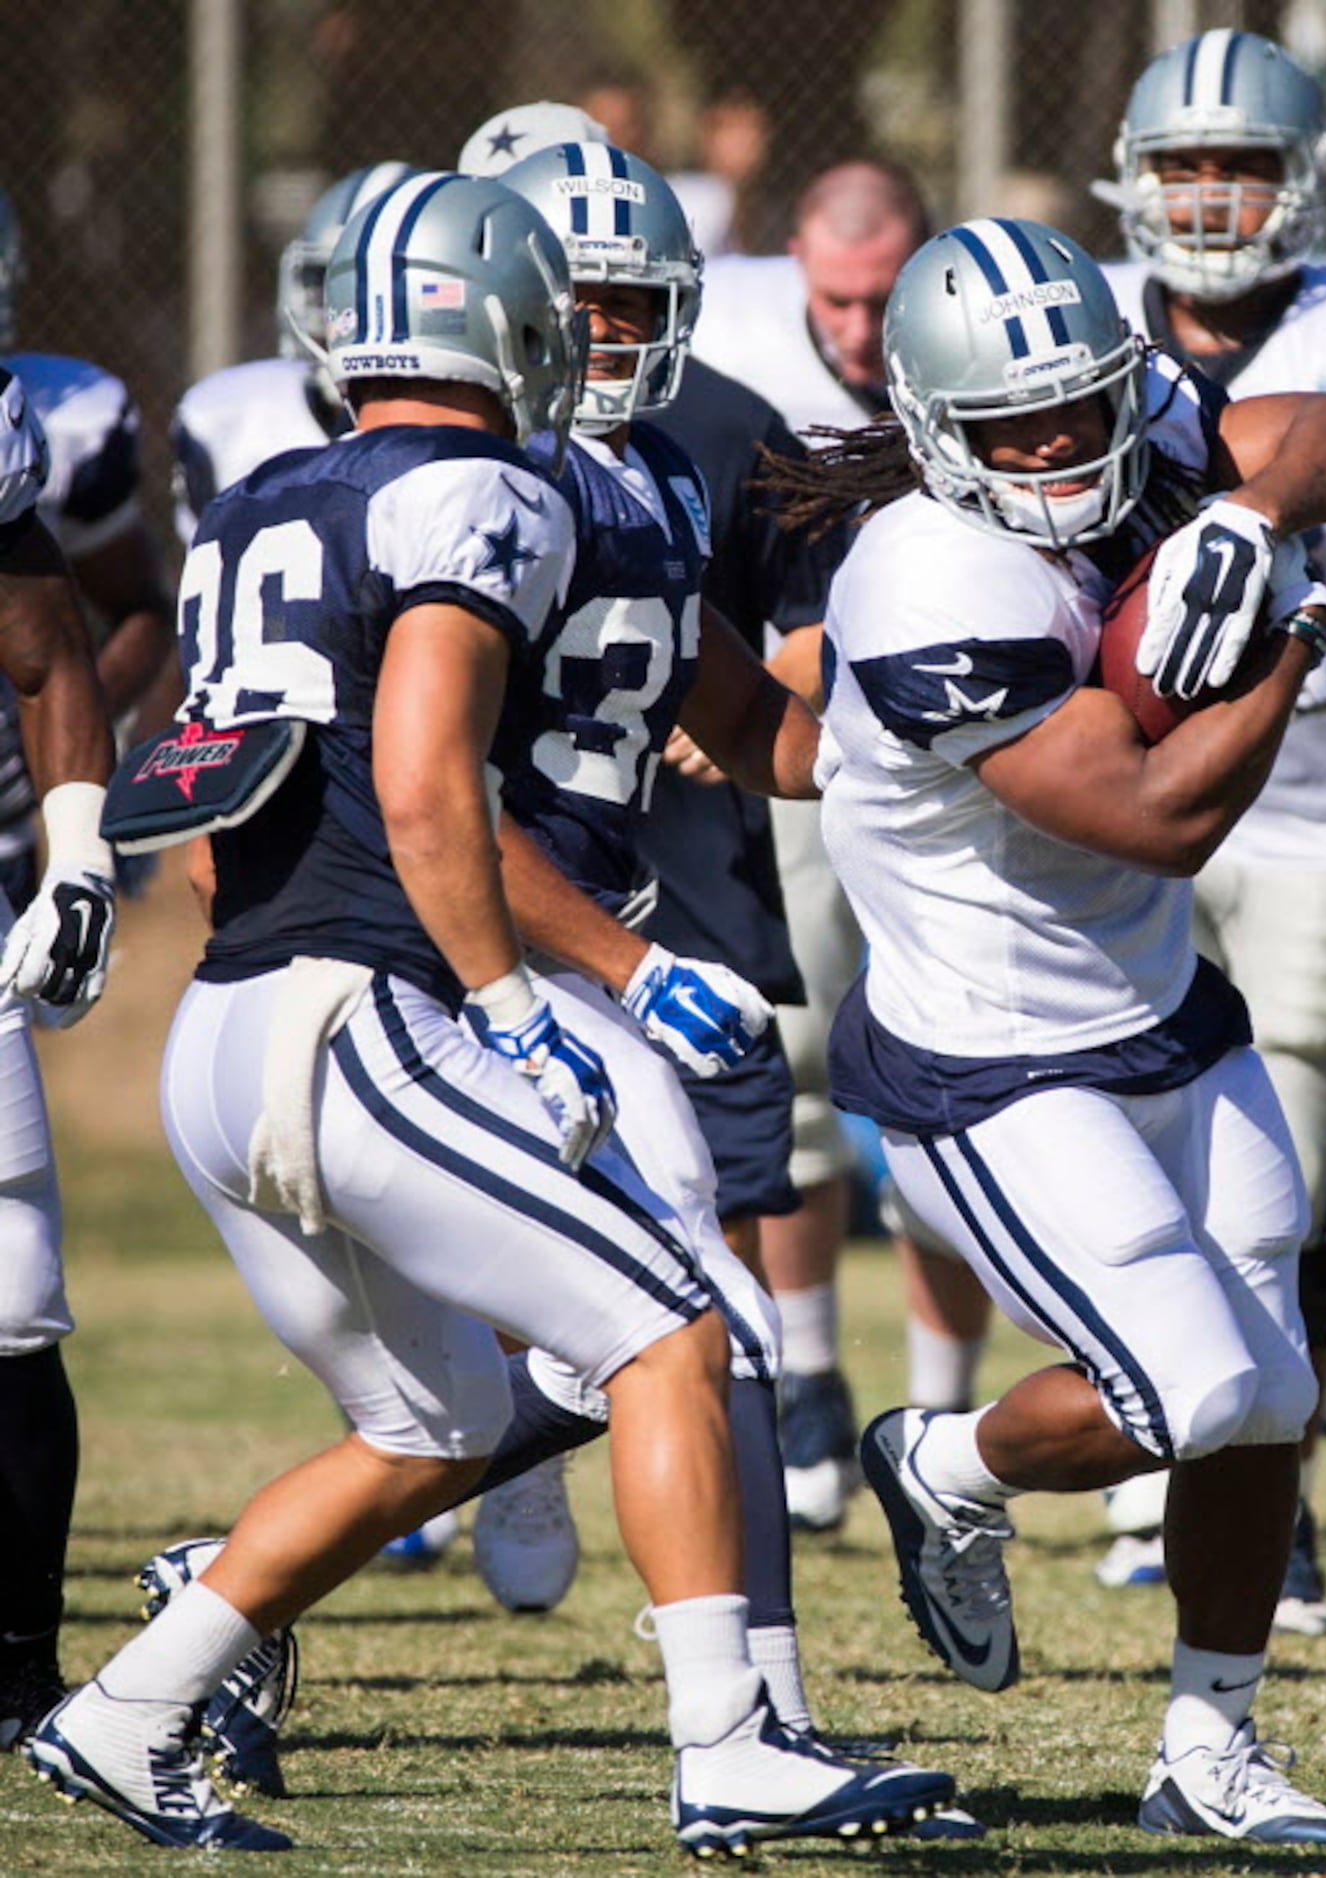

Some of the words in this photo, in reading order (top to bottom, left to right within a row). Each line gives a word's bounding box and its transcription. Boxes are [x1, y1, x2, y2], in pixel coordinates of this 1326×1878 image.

[557, 178, 639, 199] WILSON
[980, 283, 1076, 324] JOHNSON
[341, 354, 421, 371] COWBOYS
